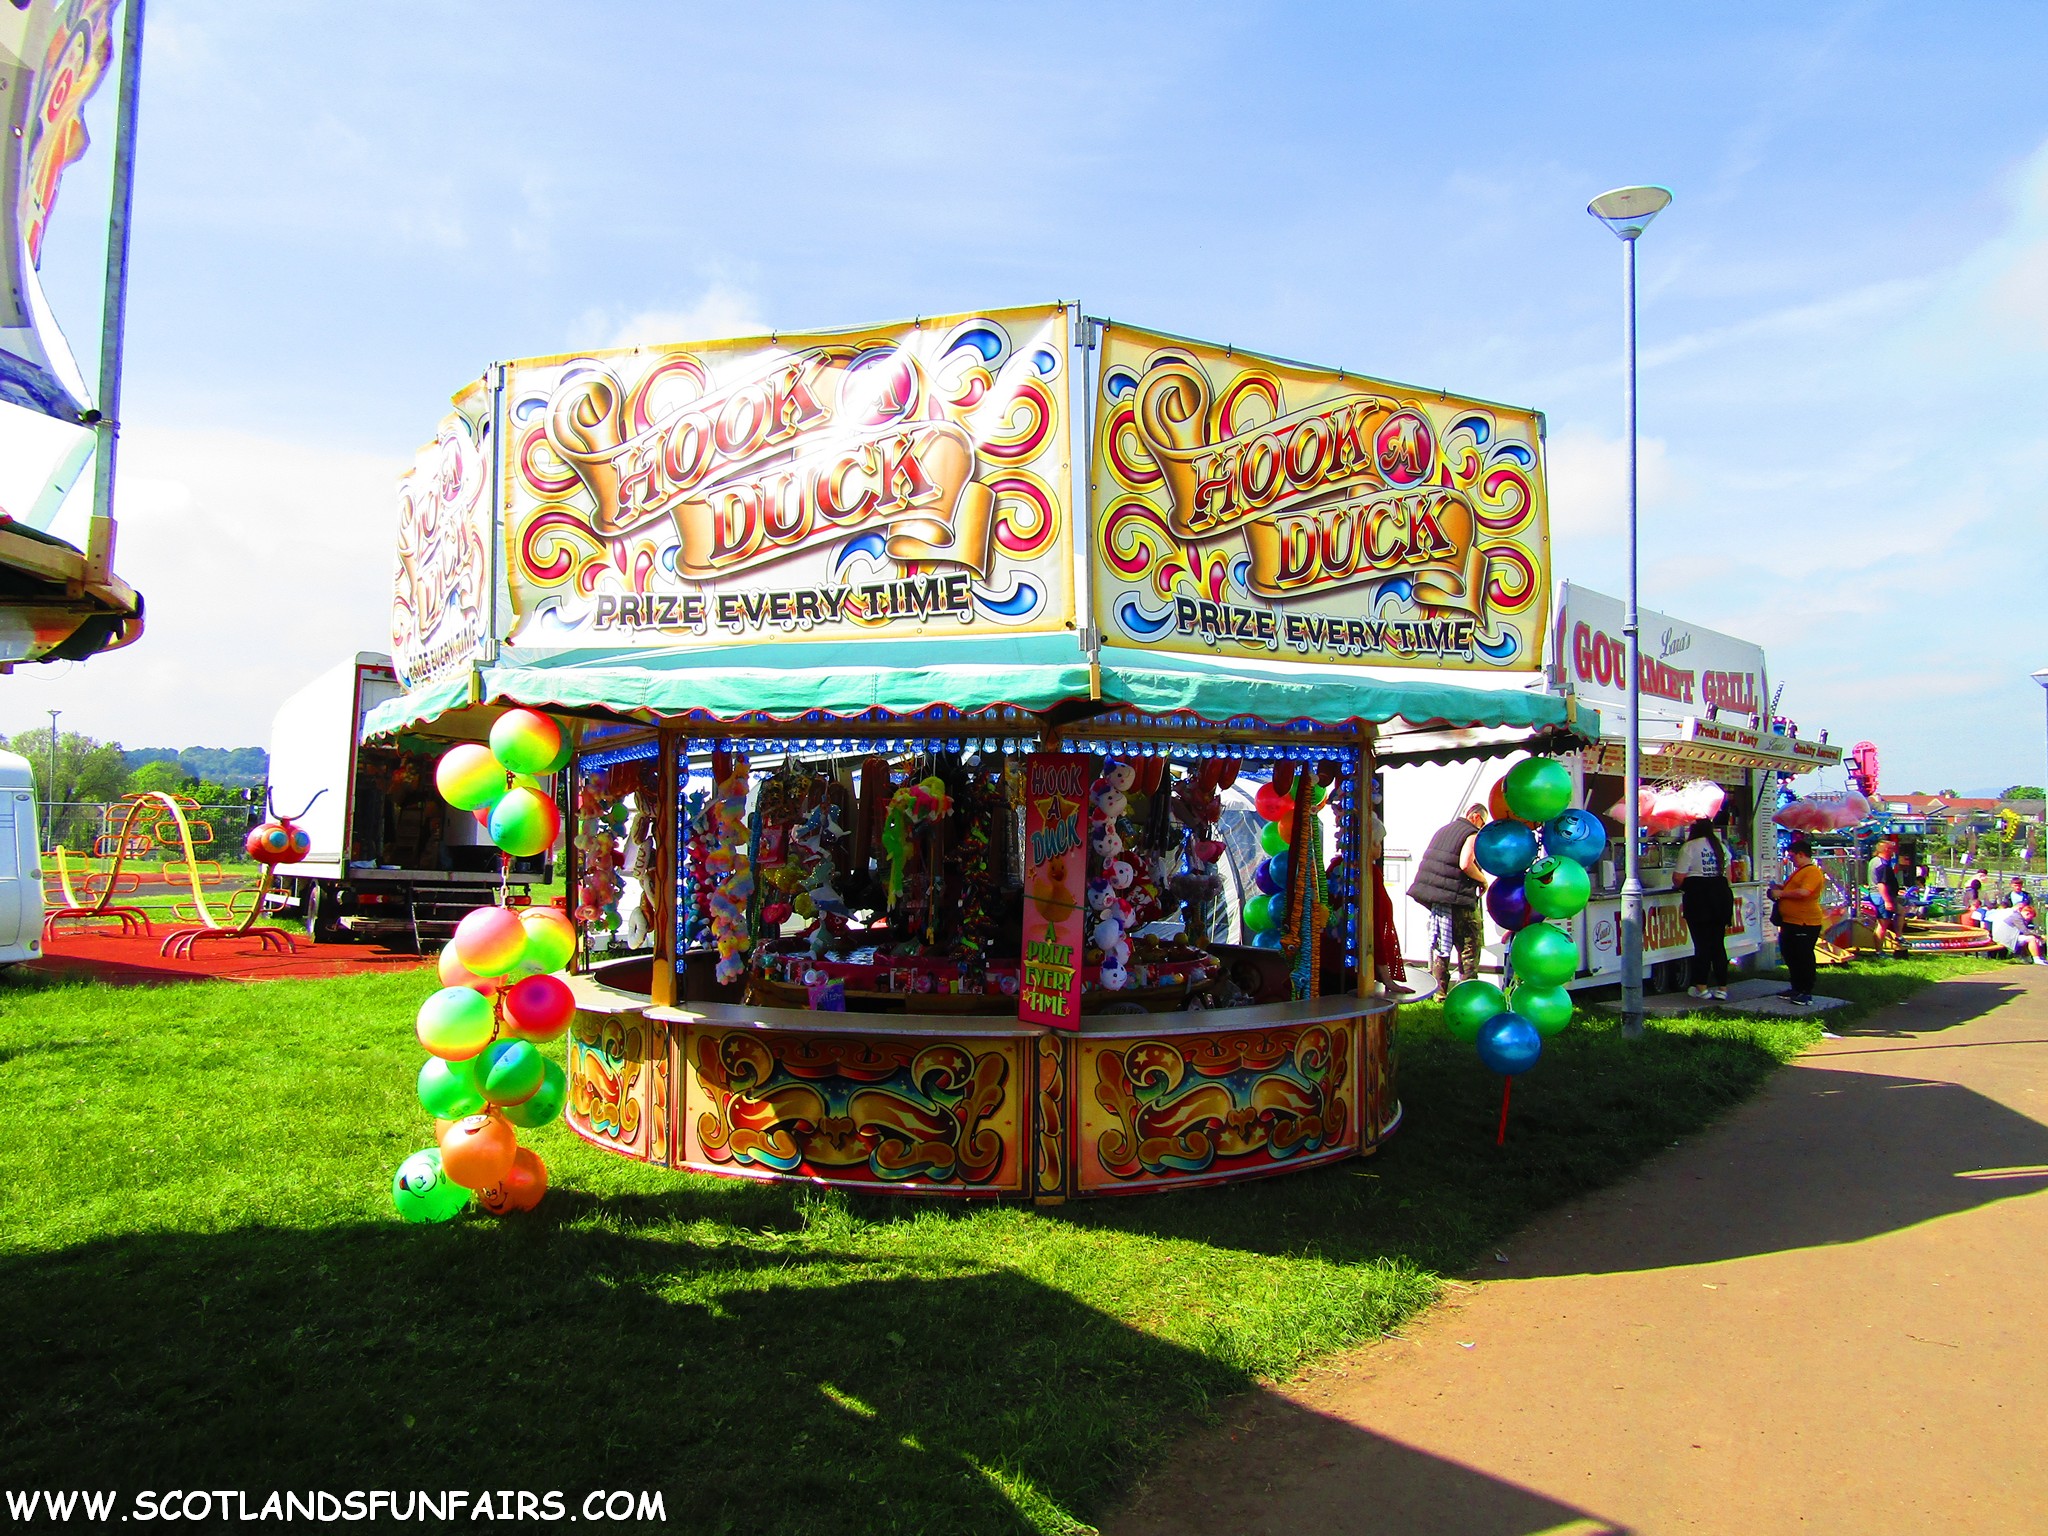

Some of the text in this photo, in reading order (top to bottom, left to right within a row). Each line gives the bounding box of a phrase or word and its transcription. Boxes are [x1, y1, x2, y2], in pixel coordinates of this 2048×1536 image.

[611, 350, 831, 528] HOOK
[1187, 398, 1426, 531] HOOK A
[707, 423, 943, 567] DUCK
[1274, 491, 1457, 589] DUCK
[594, 572, 972, 636] PRIZE EVERY TIME
[1174, 593, 1475, 662] PRIZE EVERY TIME
[1702, 670, 1758, 714] GRILL
[1697, 722, 1759, 748] Fresh and Tasty
[1793, 742, 1816, 758] Quality
[1031, 765, 1083, 797] HOOK
[1047, 795, 1061, 820] A
[1031, 813, 1081, 867] DUCK
[1044, 920, 1057, 943] A
[1614, 904, 1689, 957] GERS
[1027, 940, 1073, 967] PRIZE
[1025, 966, 1074, 993] EVERY
[1029, 991, 1067, 1018] TIME
